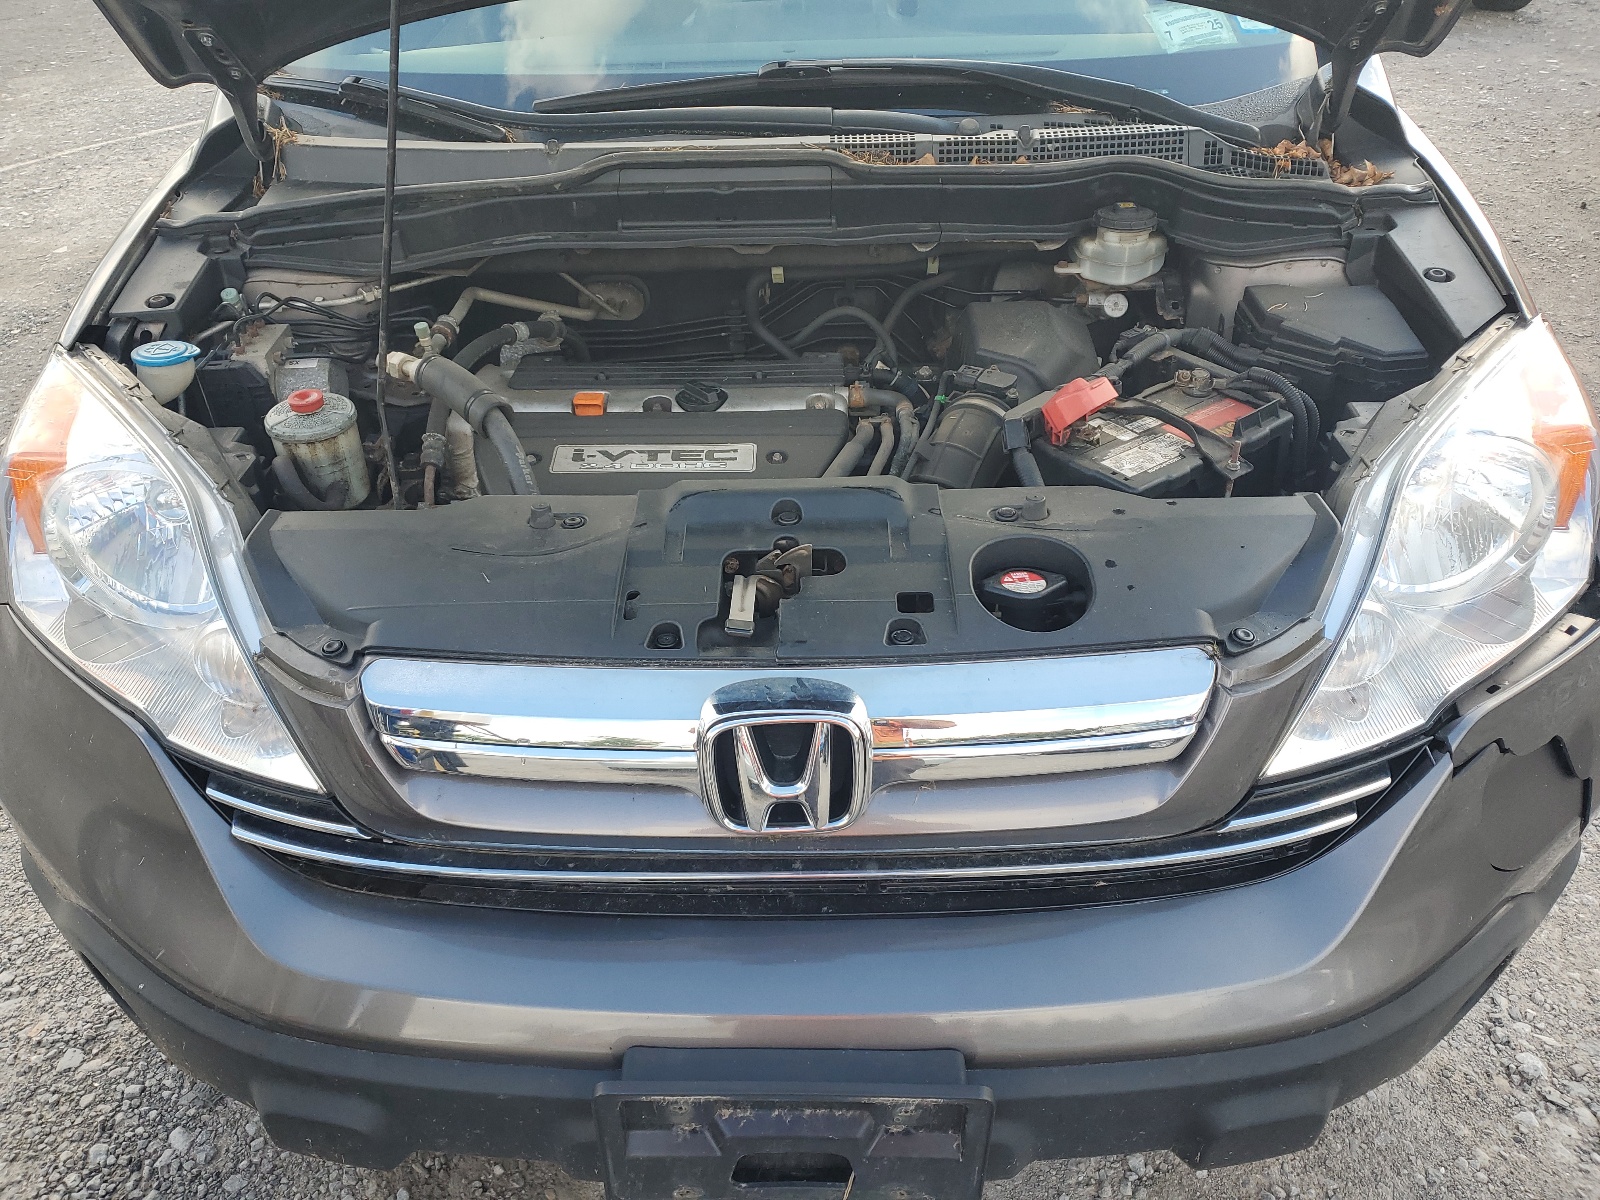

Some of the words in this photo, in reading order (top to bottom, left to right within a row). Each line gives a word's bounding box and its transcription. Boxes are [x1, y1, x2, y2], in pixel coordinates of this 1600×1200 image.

[1207, 18, 1224, 31] 25
[1164, 30, 1174, 41] 7
[571, 448, 739, 462] i-VTEC
